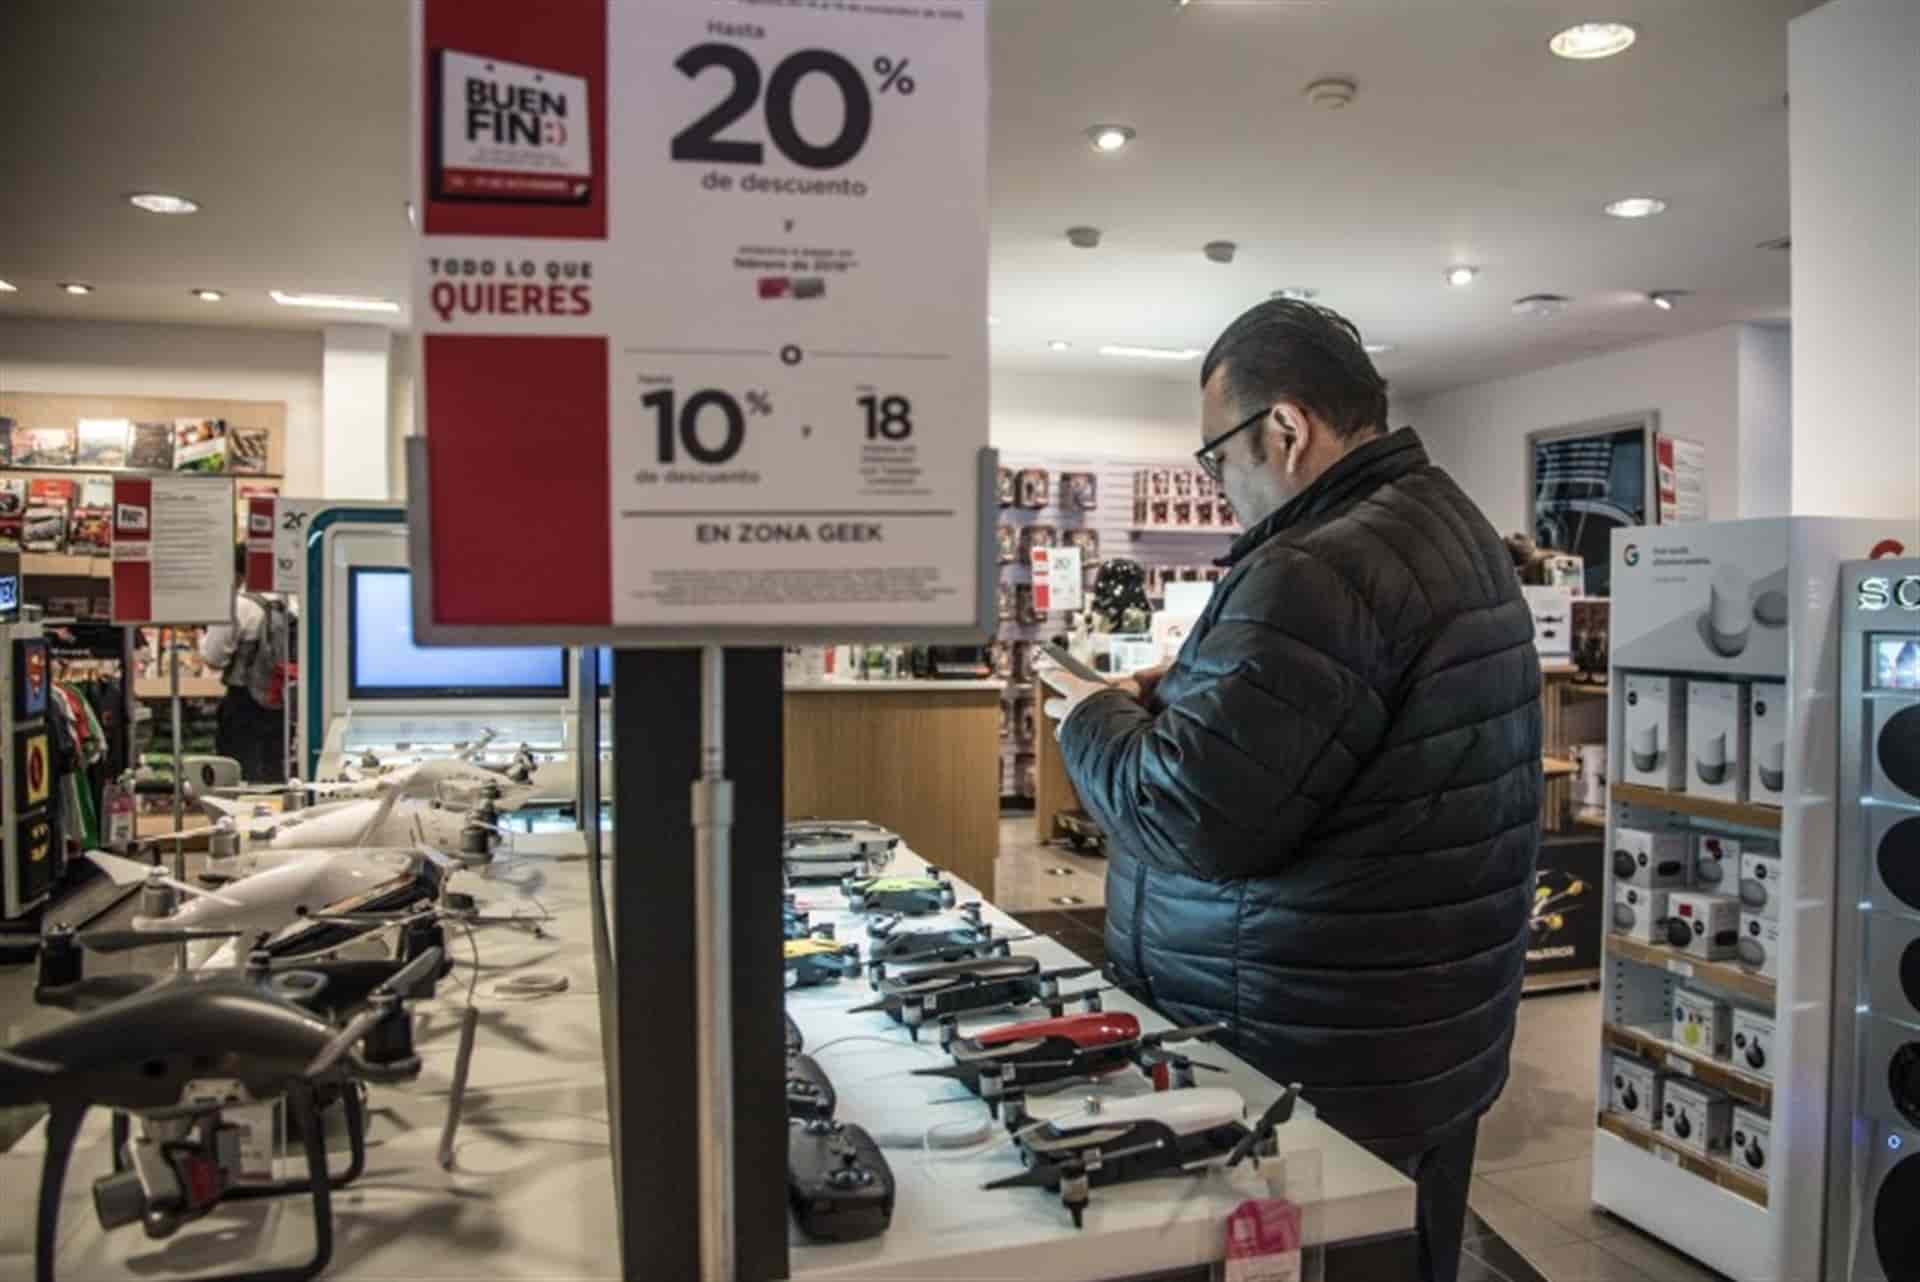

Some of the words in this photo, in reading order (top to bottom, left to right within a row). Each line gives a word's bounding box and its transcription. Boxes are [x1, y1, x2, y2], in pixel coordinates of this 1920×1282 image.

[706, 20, 765, 39] Hasta
[466, 78, 567, 117] BUEN
[700, 170, 734, 190] de
[740, 171, 868, 197] descuento
[429, 258, 496, 276] TODO
[506, 260, 537, 278] LO
[546, 260, 592, 282] QUE
[431, 281, 592, 321] QUIERES
[857, 395, 912, 440] 18
[635, 472, 659, 484] de
[663, 470, 761, 485] descuento
[696, 524, 731, 543] EN
[738, 523, 811, 543] ZONA
[817, 523, 882, 543] GEEK
